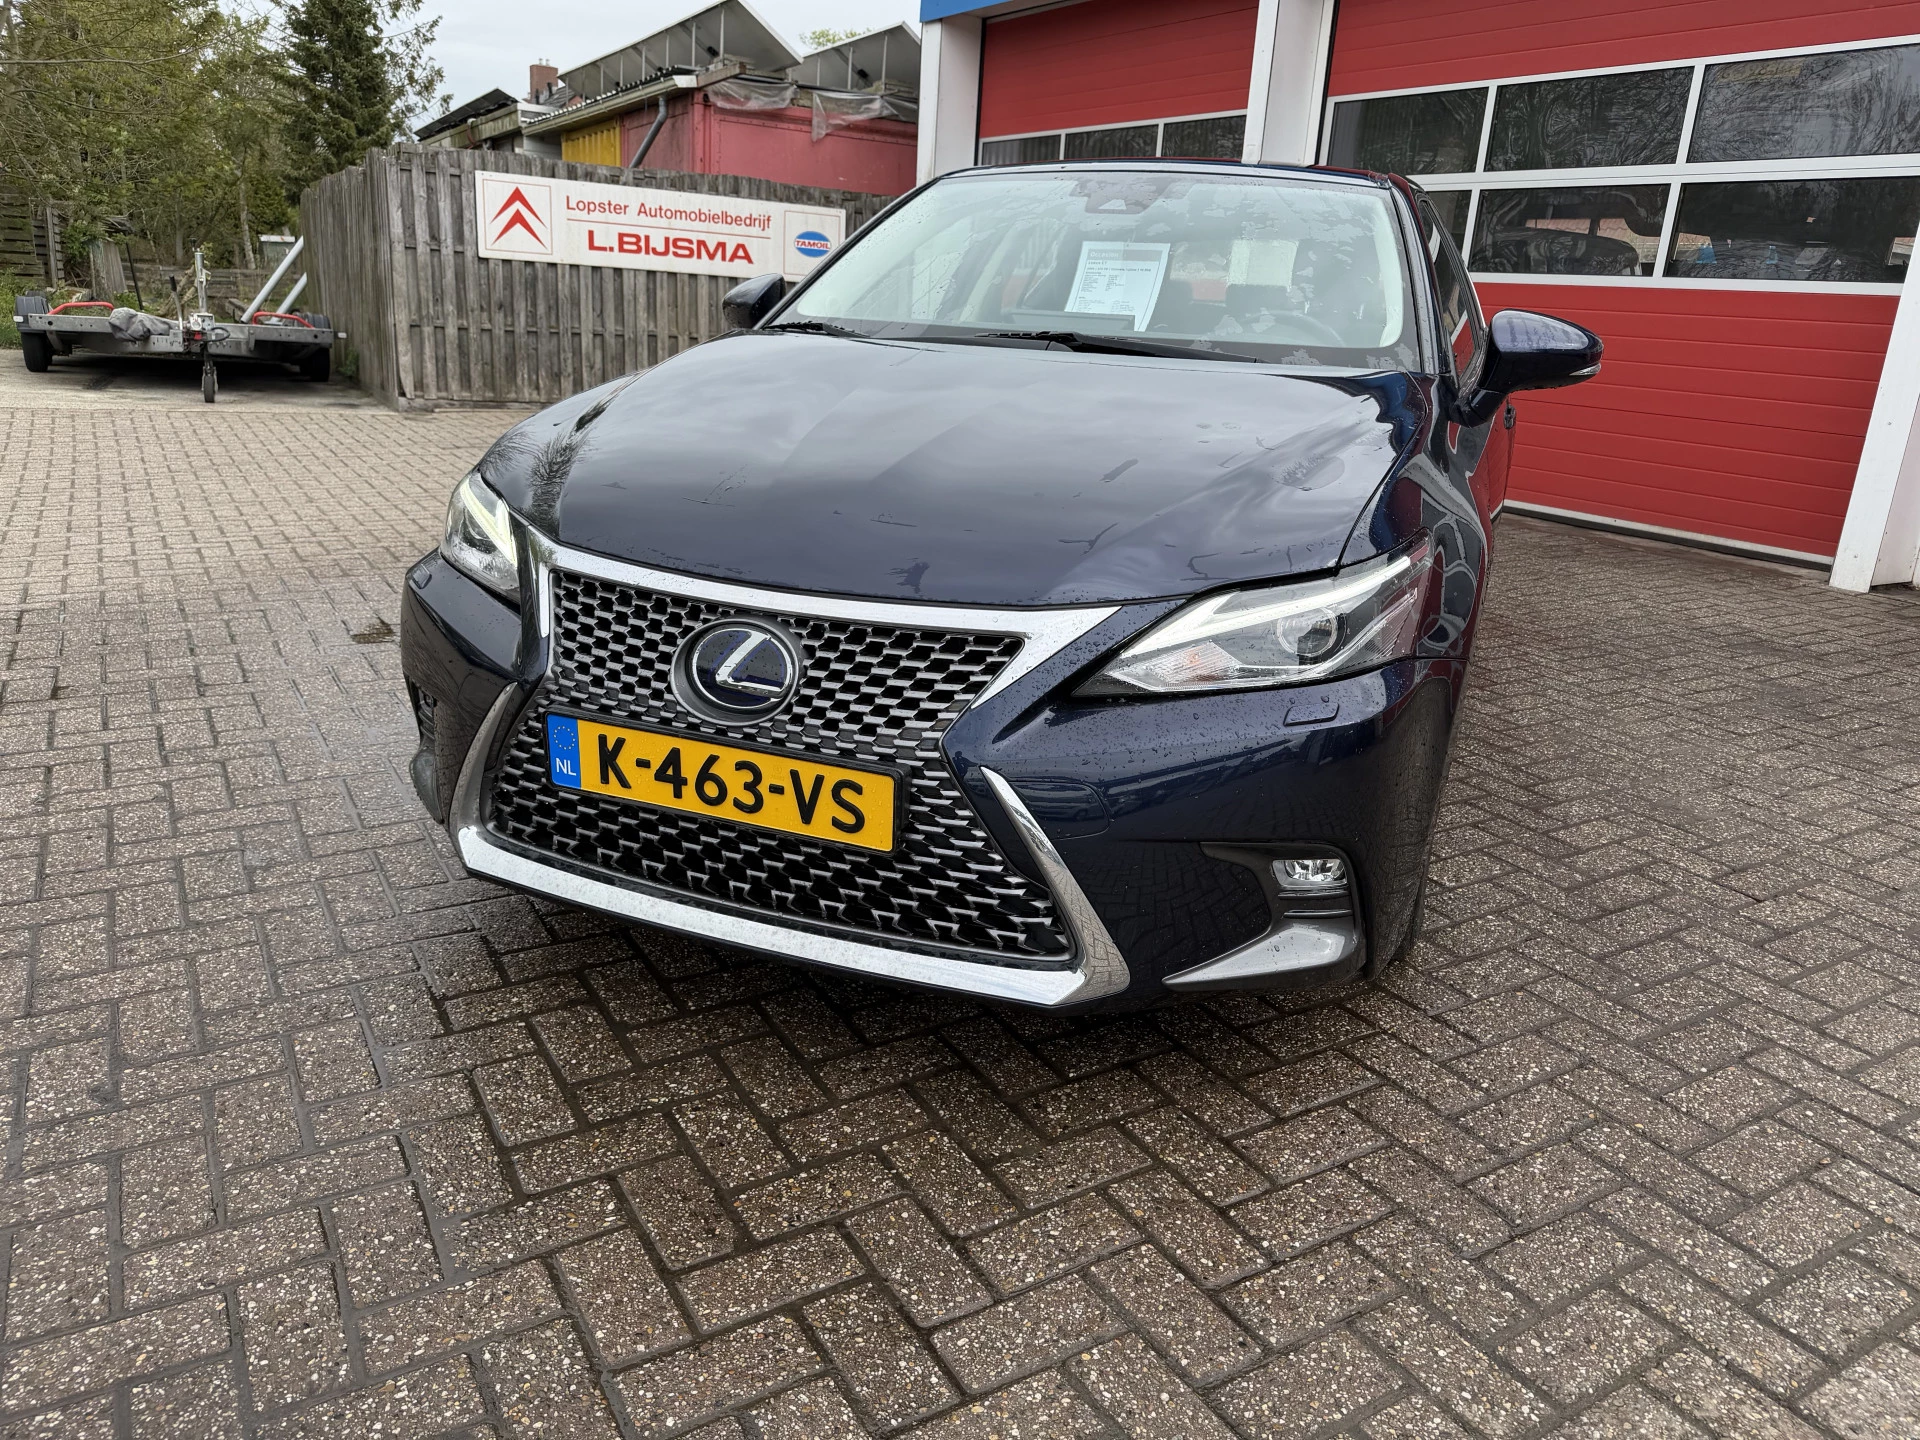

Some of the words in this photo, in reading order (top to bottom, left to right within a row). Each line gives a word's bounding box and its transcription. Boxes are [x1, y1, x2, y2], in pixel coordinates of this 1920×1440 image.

[565, 195, 630, 215] Lopster
[637, 201, 772, 230] Automobielbedrijf
[587, 229, 754, 265] L.BIJSMA
[795, 240, 831, 250] TAMOIL
[555, 757, 577, 777] NL
[597, 733, 866, 834] K-463-VS
